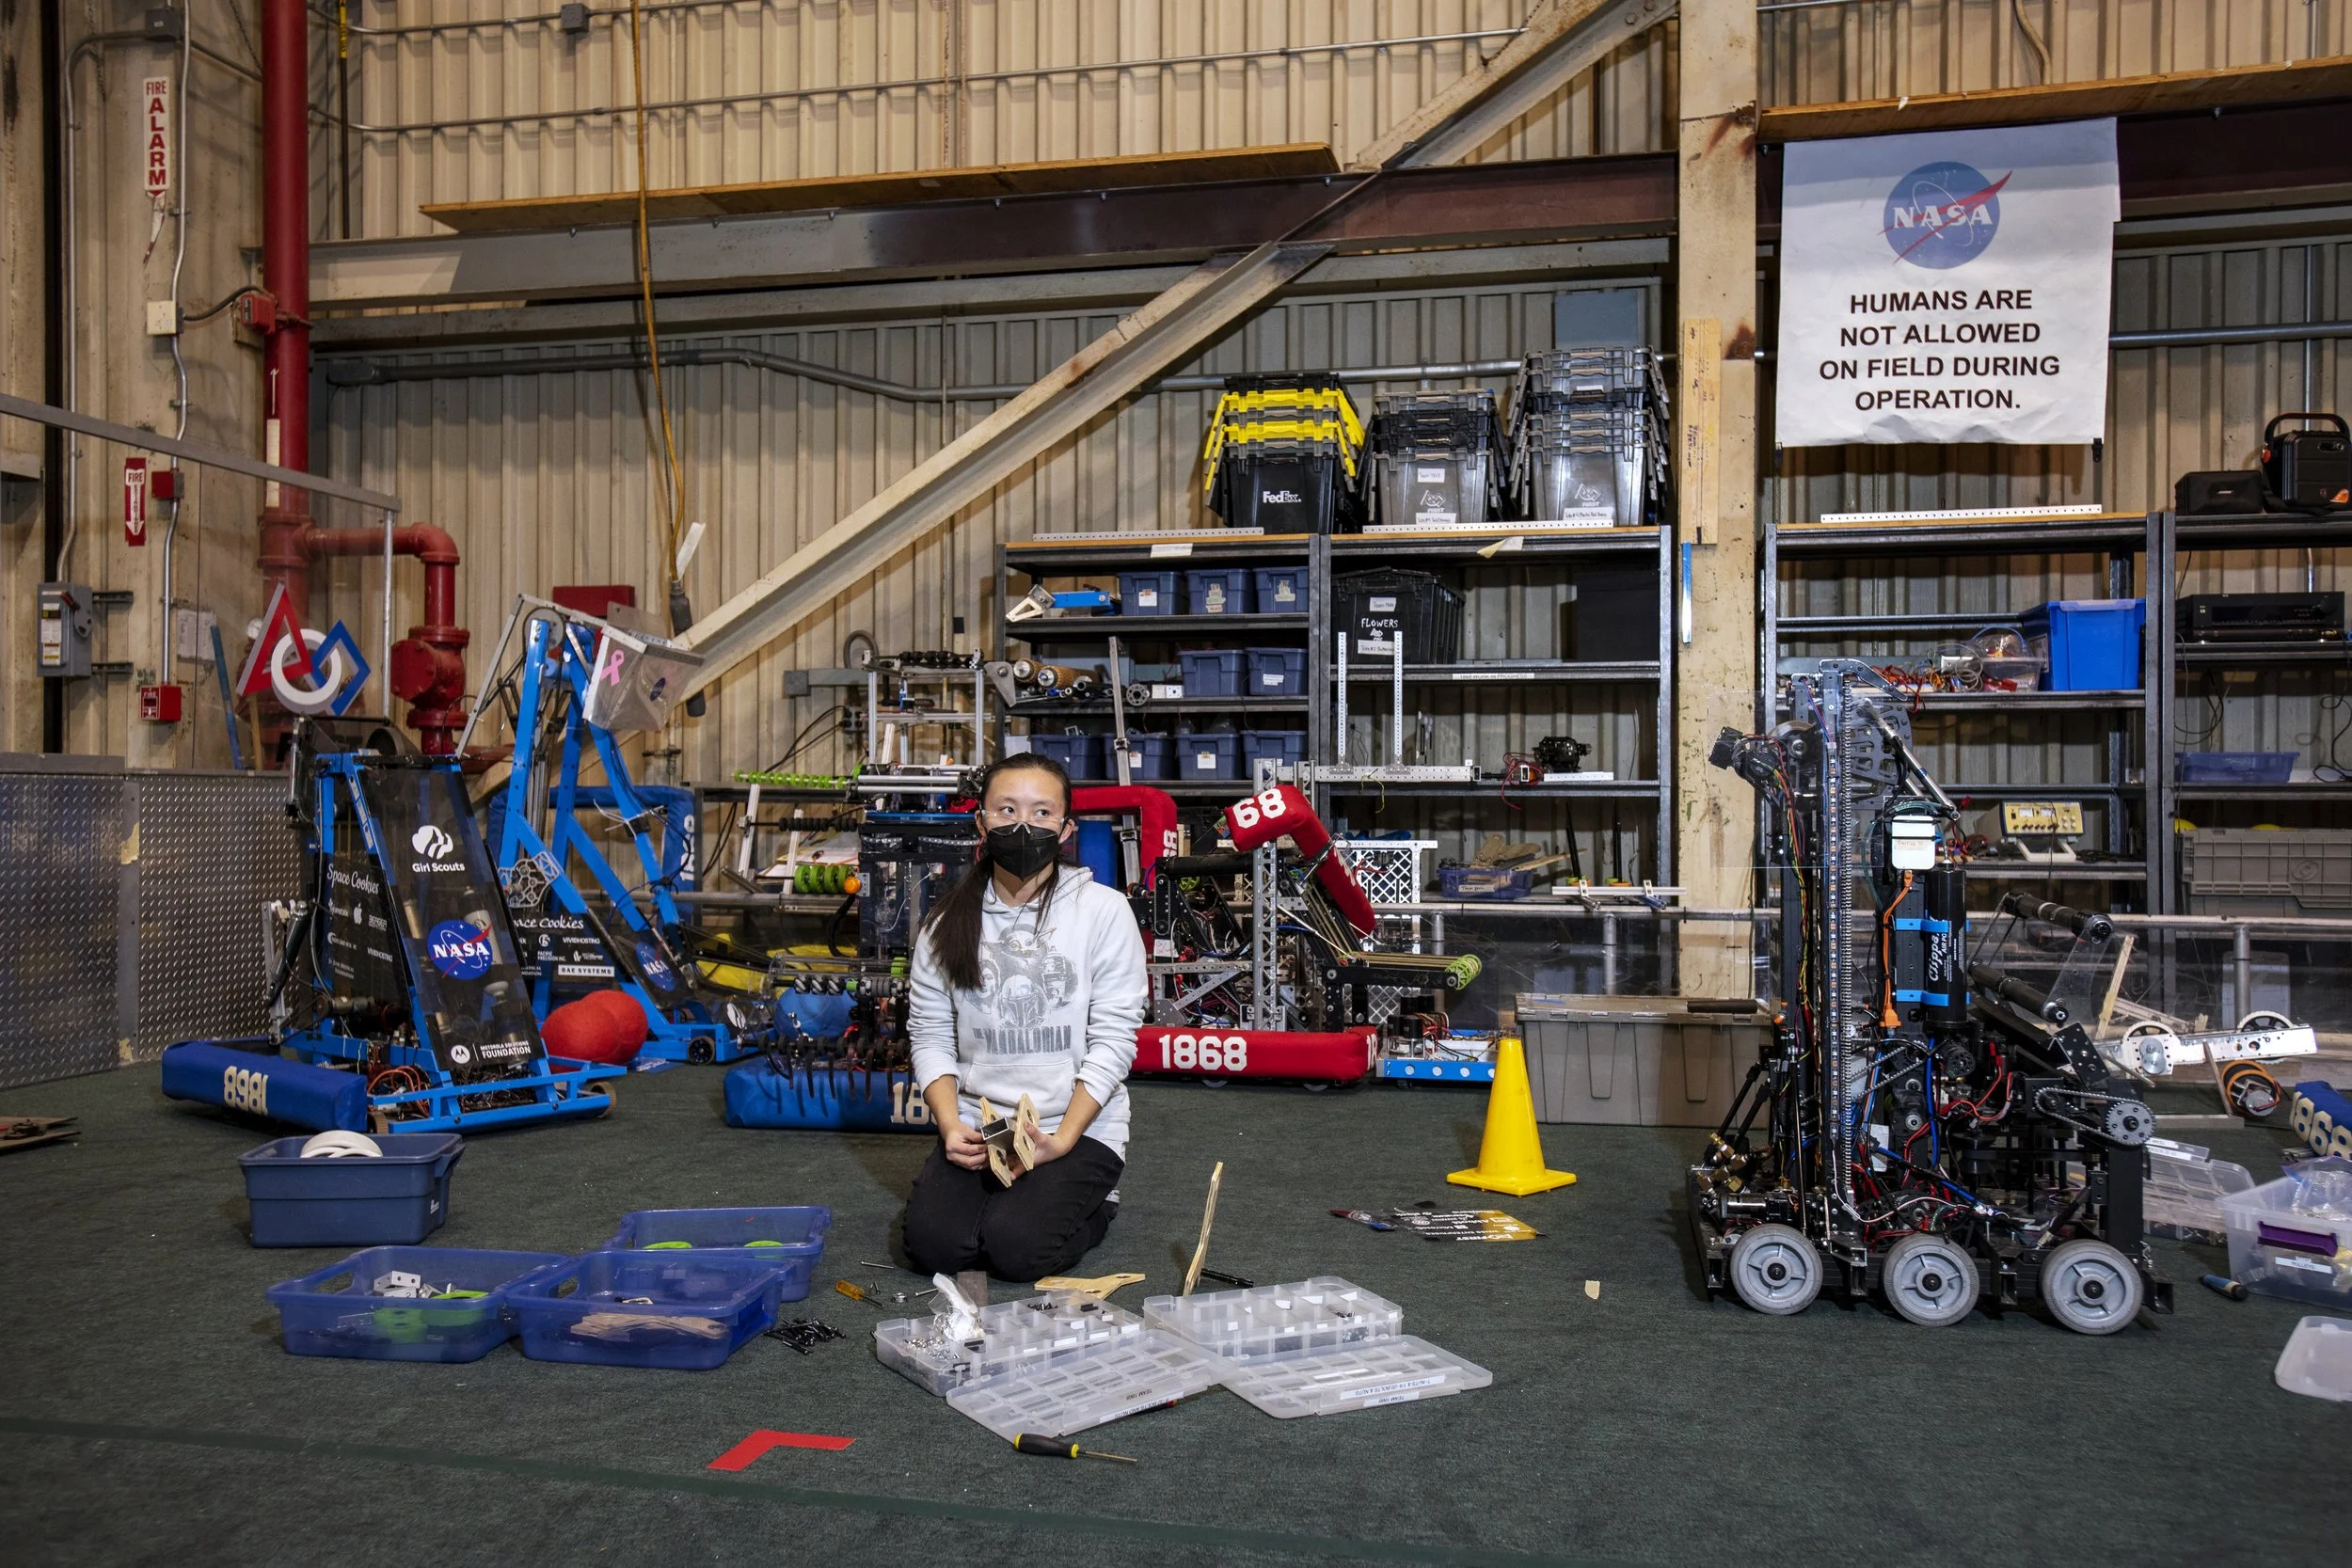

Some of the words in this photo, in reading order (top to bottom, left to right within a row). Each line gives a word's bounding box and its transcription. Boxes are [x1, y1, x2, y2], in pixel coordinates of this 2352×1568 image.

[146, 81, 167, 95] FIRE
[149, 97, 167, 186] ALARM
[1893, 204, 1993, 230] NASA
[1851, 291, 1967, 313] HUMANS
[1975, 290, 2032, 309] ARE
[1841, 326, 1897, 346] NOT
[1903, 323, 2041, 344] ALLOWED
[1820, 359, 1857, 380] ON
[1867, 356, 1944, 378] FIELD
[1953, 356, 2060, 376] DURING
[1854, 389, 2021, 411] OPERATION.
[128, 472, 142, 483] FIRE
[1361, 618, 1399, 628] FLOWERS
[1232, 788, 1287, 829] 68
[326, 863, 350, 888] Space
[351, 870, 379, 895] Cookies
[412, 863, 431, 873] Girl
[432, 863, 466, 873] Scouts
[513, 918, 538, 928] ace
[539, 914, 584, 929] Cookies
[433, 943, 490, 958] NASA
[644, 960, 669, 975] NASA
[480, 1043, 504, 1052] MOTOROLA
[482, 1046, 532, 1059] FOUNDATION
[1159, 1035, 1248, 1071] 1868
[890, 1082, 938, 1125] 18
